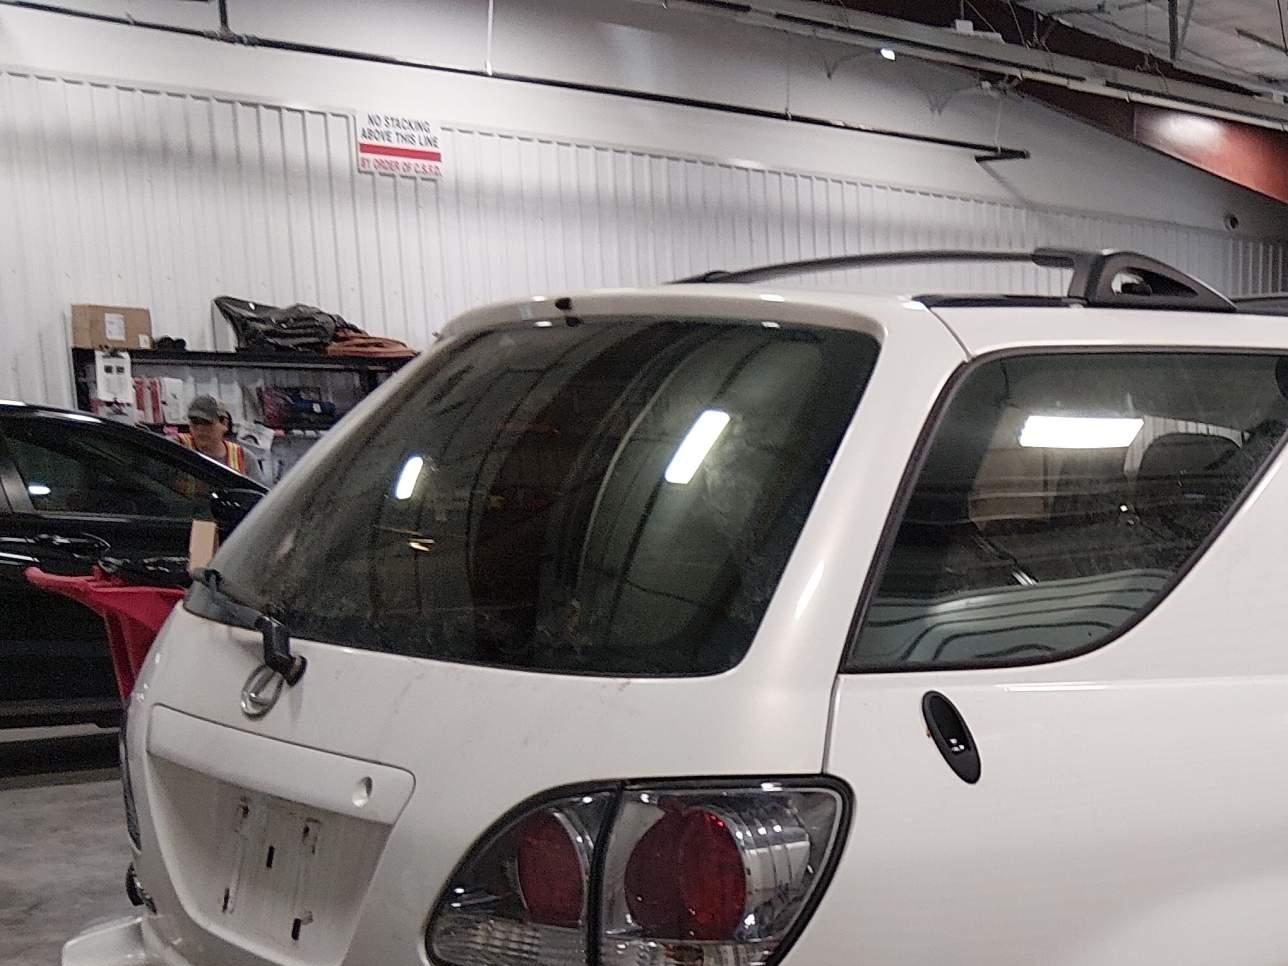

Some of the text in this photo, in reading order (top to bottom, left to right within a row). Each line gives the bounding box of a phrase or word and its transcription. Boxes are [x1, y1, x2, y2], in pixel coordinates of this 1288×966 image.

[368, 113, 431, 133] NO STACKING
[361, 127, 440, 148] ABOVE THIS LINE
[373, 158, 400, 172] ORDER
[402, 161, 412, 173] OF
